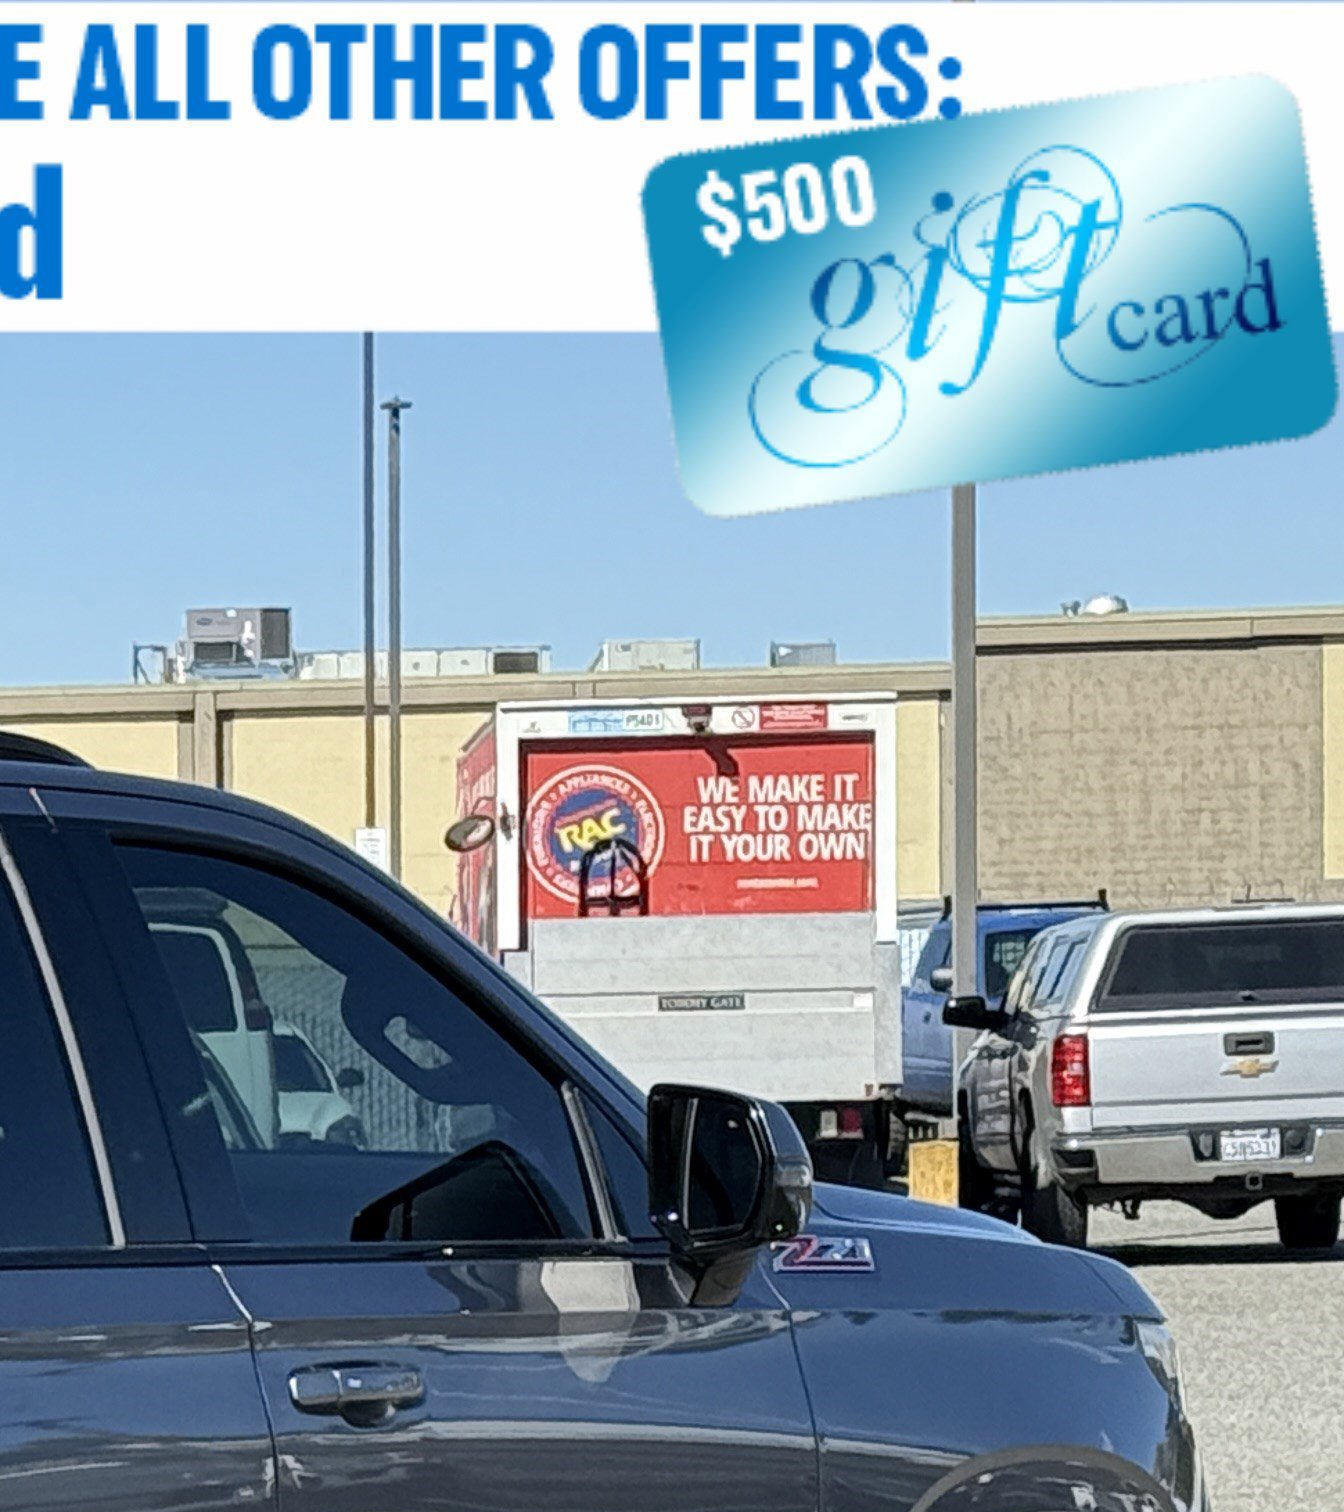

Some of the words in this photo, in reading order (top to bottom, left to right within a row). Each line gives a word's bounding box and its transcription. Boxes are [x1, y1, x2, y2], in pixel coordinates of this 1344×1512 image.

[697, 776, 739, 803] WE
[747, 774, 825, 801] MAKE
[833, 773, 859, 800] IT
[554, 807, 627, 853] RAC
[683, 805, 747, 832] EASY
[754, 805, 789, 831] TO
[797, 803, 872, 830] MAKE
[690, 834, 715, 862] IT
[721, 834, 791, 861] YOUR
[799, 832, 865, 860] OWN
[770, 1234, 875, 1273] Z71
